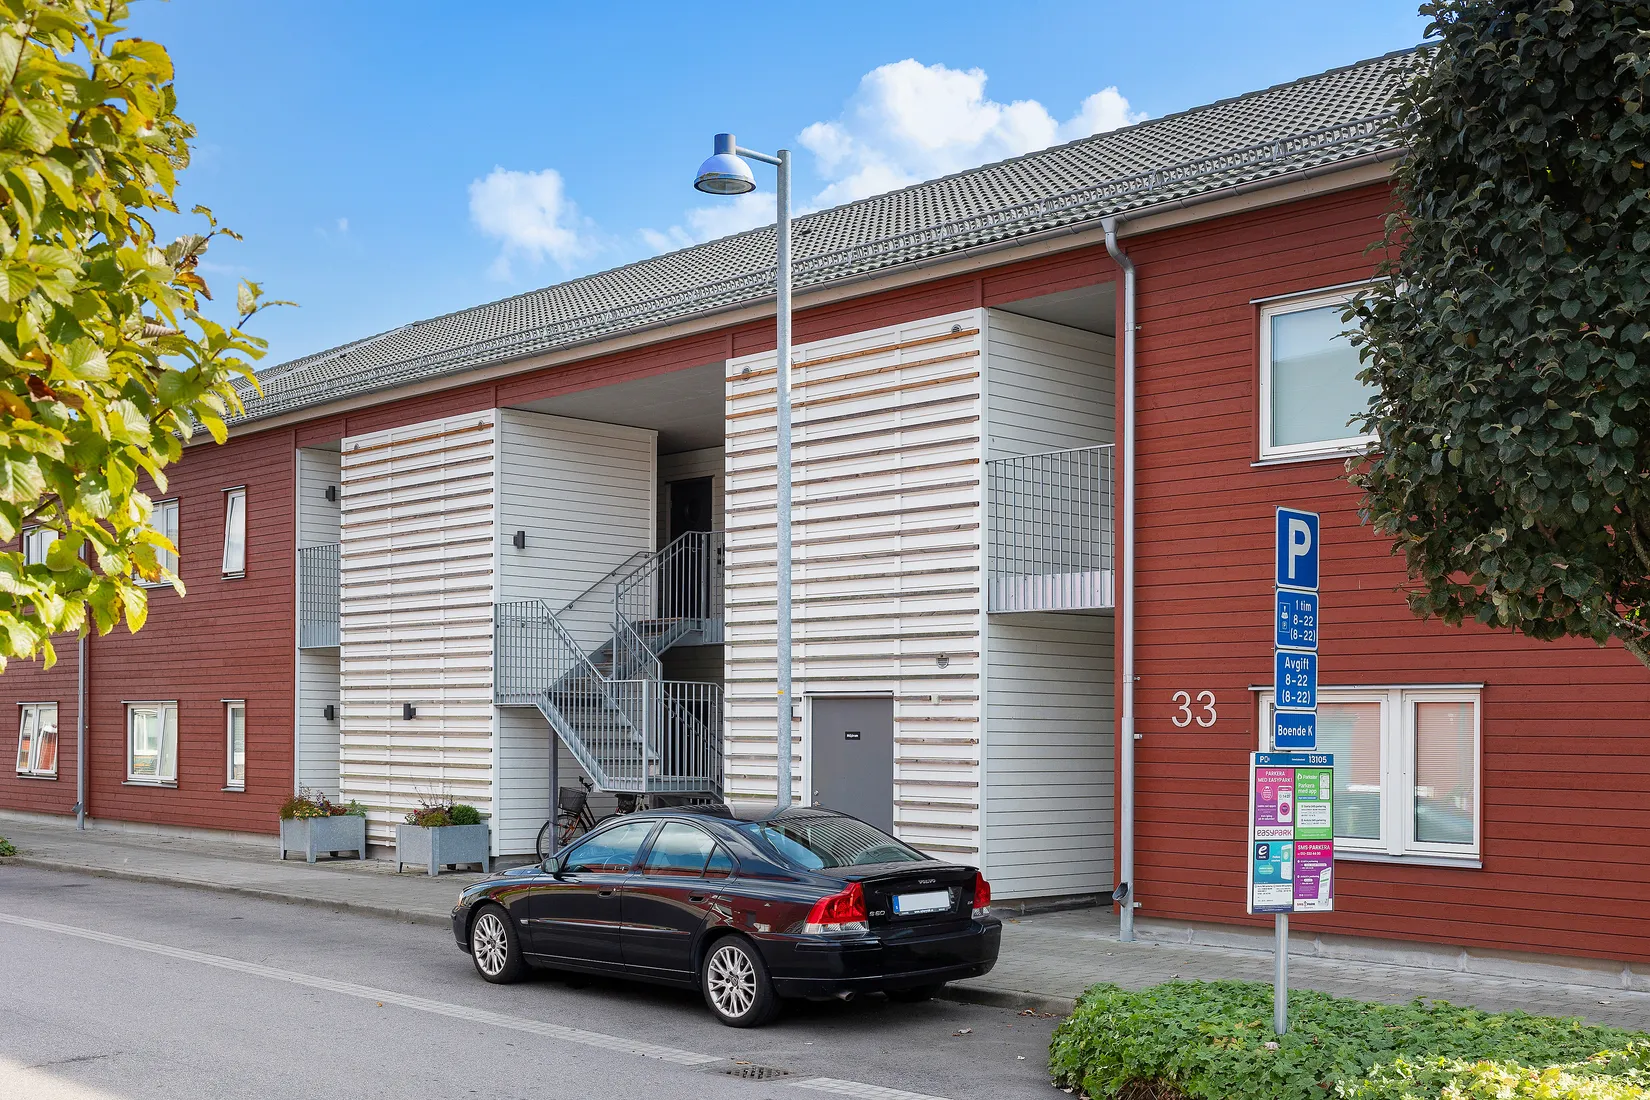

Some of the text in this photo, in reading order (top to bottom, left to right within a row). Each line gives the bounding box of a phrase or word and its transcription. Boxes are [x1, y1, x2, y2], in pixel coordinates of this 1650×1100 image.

[1288, 518, 1312, 579] P
[1295, 600, 1312, 612] 1 tim
[1293, 614, 1314, 626] 8-22
[1290, 628, 1316, 642] (8-22)
[1284, 656, 1309, 672] Avgift
[1286, 674, 1308, 686] 8-22
[1282, 690, 1310, 704] (8-22)
[1172, 690, 1217, 728] 33
[1278, 724, 1313, 736] Boende K
[1309, 756, 1328, 764] 13105
